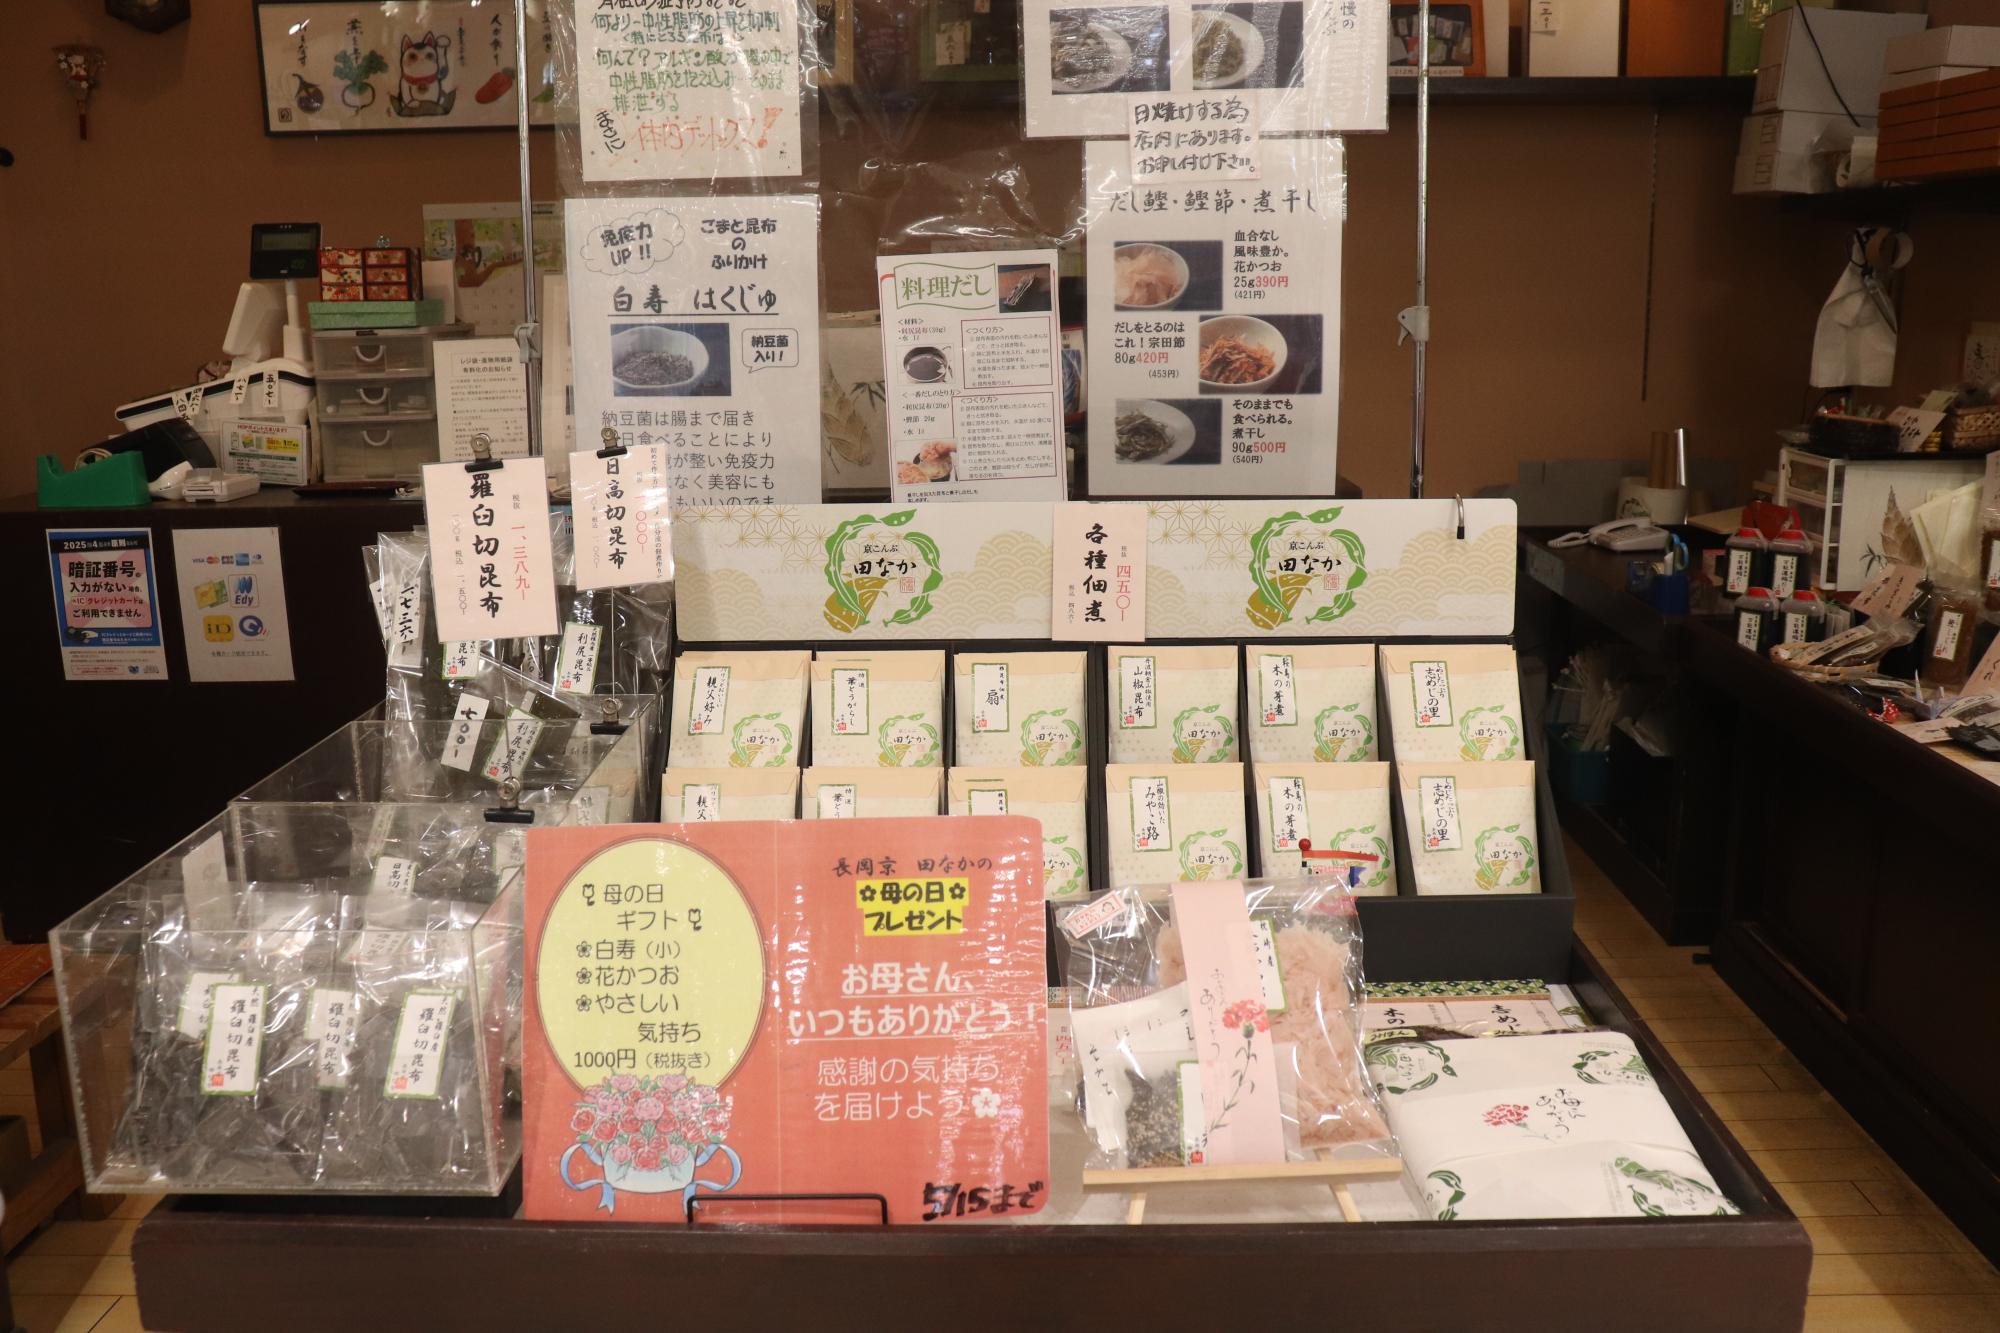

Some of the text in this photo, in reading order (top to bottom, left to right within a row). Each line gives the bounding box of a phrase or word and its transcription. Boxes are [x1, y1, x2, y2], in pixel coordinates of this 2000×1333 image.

[1134, 128, 1252, 150] 店内にあります。
[701, 217, 777, 235] ごまと昆布
[600, 222, 653, 248] 免疫力
[1234, 230, 1279, 242] 血合なし
[731, 236, 747, 252] の
[1233, 245, 1289, 258] 風味豊か。
[711, 254, 768, 270] ふりかけ
[1234, 260, 1282, 273] 花かつお
[901, 273, 993, 301] 料理だし
[1234, 276, 1288, 289] 25g390円
[694, 283, 777, 313] はくじゅ
[1114, 322, 1185, 334] だしをとるのは
[751, 334, 788, 348] 納豆菌
[1114, 336, 1185, 349] これ！宗田節
[1114, 351, 1169, 365] 80g420円
[1232, 398, 1293, 411] そのままでも
[601, 410, 755, 428] 納豆菌は腸まで届き
[1232, 414, 1293, 425] 食べられる。
[620, 431, 773, 448] 日食べることにより
[1232, 428, 1265, 439] 煮干し
[1232, 441, 1286, 454] 90g500円
[512, 494, 521, 510] 税抜
[604, 457, 628, 570] 日高切昆布
[469, 472, 504, 619] 羅臼切昆布
[853, 557, 917, 577] 田なか
[1083, 523, 1108, 622] 各種佃煮
[1278, 554, 1342, 574] 田なか
[234, 594, 254, 607] Edy
[573, 631, 588, 684] 利尻昆布
[985, 689, 999, 706] 扇
[1132, 665, 1145, 719] 山椒昆布
[746, 733, 780, 745] 田なか
[893, 734, 927, 745] 田なか
[1034, 731, 1069, 742] 田なか
[1188, 728, 1221, 739] 田なか
[1328, 728, 1361, 738] 田なか
[1474, 726, 1508, 738] 田なか
[1195, 854, 1230, 864] 田なか
[1489, 849, 1523, 860] 田なか
[917, 855, 993, 873] 田なかの
[603, 884, 663, 905] 母の日
[880, 881, 945, 905] 母の日
[616, 909, 678, 931] ギフト
[864, 909, 962, 933] プレゼント
[595, 965, 679, 987] 花かつお
[595, 994, 679, 1014] やさしい
[225, 998, 247, 1080] 羅臼切昆布
[321, 1002, 345, 1076] 羅臼切昆布
[638, 1021, 702, 1043] 気持ち
[409, 1007, 435, 1084] 羅臼切昆布
[817, 1055, 1000, 1086] 感謝の気持ち
[814, 1091, 963, 1122] を届けよう
